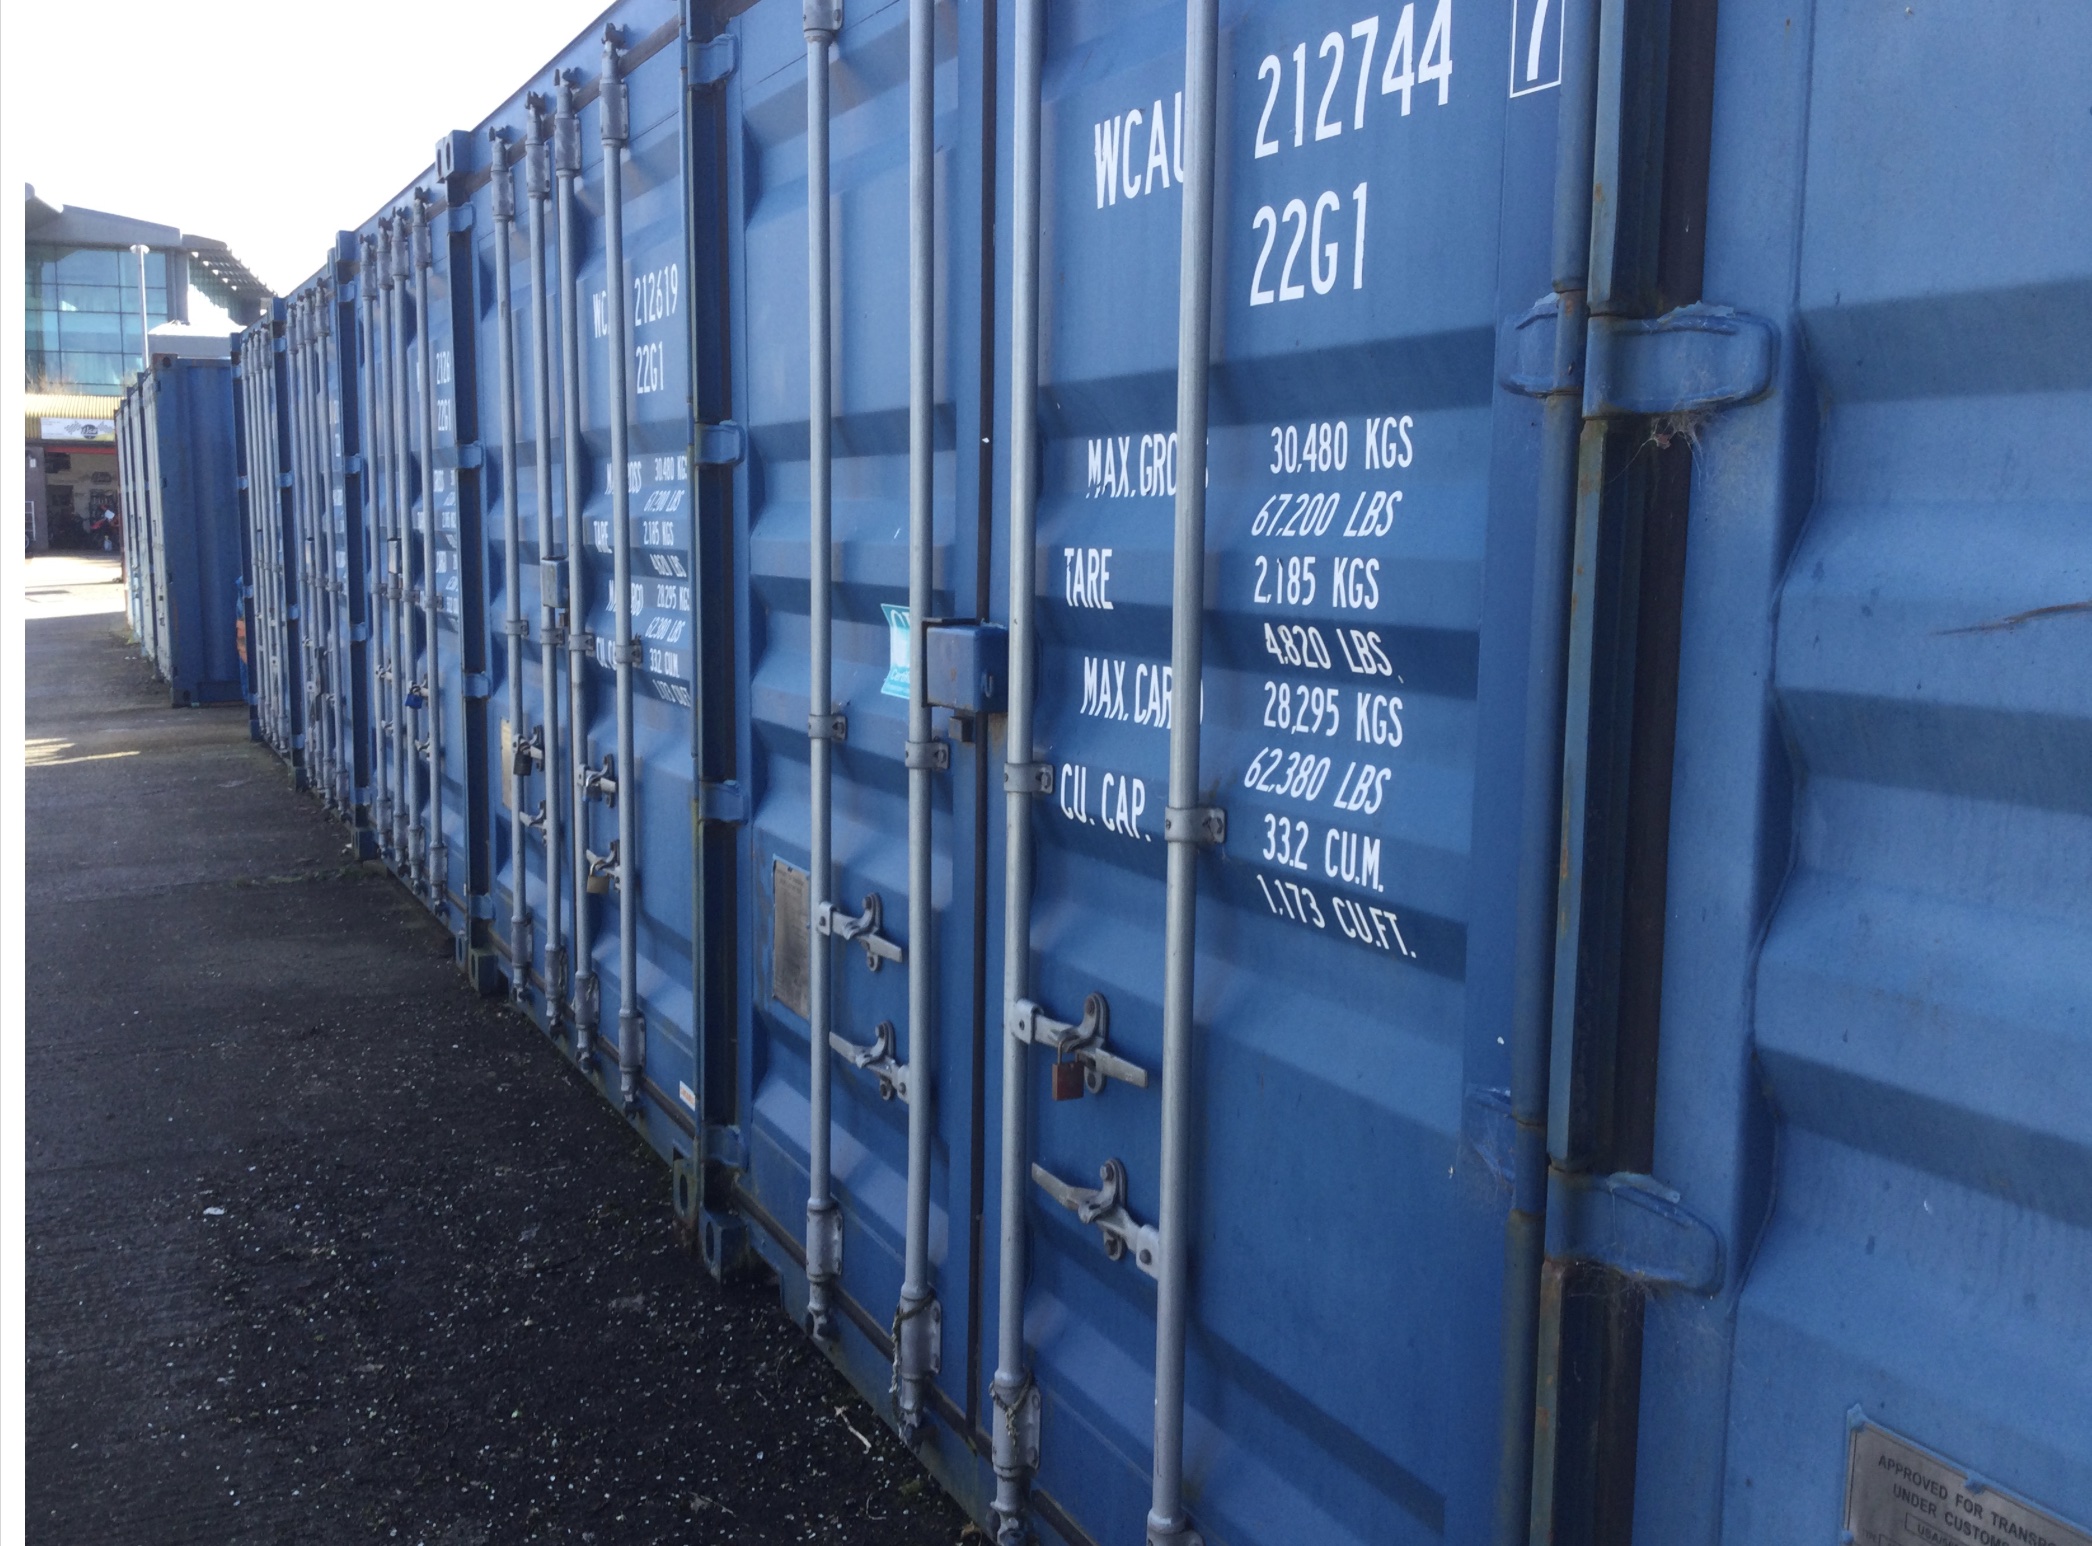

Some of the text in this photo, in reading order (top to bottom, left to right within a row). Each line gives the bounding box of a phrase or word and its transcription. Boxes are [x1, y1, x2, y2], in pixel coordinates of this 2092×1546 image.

[1254, 0, 1453, 159] 212744
[1249, 182, 1368, 306] 22G1
[634, 263, 679, 327] 212619
[635, 340, 664, 394] 22G1
[1270, 420, 1348, 474] 30,480
[1365, 414, 1414, 470] KGS
[1251, 490, 1403, 537] 67,200 LBS
[1063, 547, 1380, 610] TARE 2,185 KGS
[1263, 622, 1393, 676] 4,820 LBS
[1263, 681, 1340, 737] 28,295
[1356, 691, 1403, 748] KGS
[1244, 746, 1392, 815] 62,380 LBS
[1060, 762, 1096, 826] CU.
[1101, 772, 1152, 843] CAP.
[1262, 813, 1310, 871] 33.2
[1256, 874, 1326, 929] 1,173
[1878, 1454, 1949, 1501] APPROVED
[1955, 1492, 1983, 1520] FOR
[1892, 1482, 1937, 1519] UNDER
